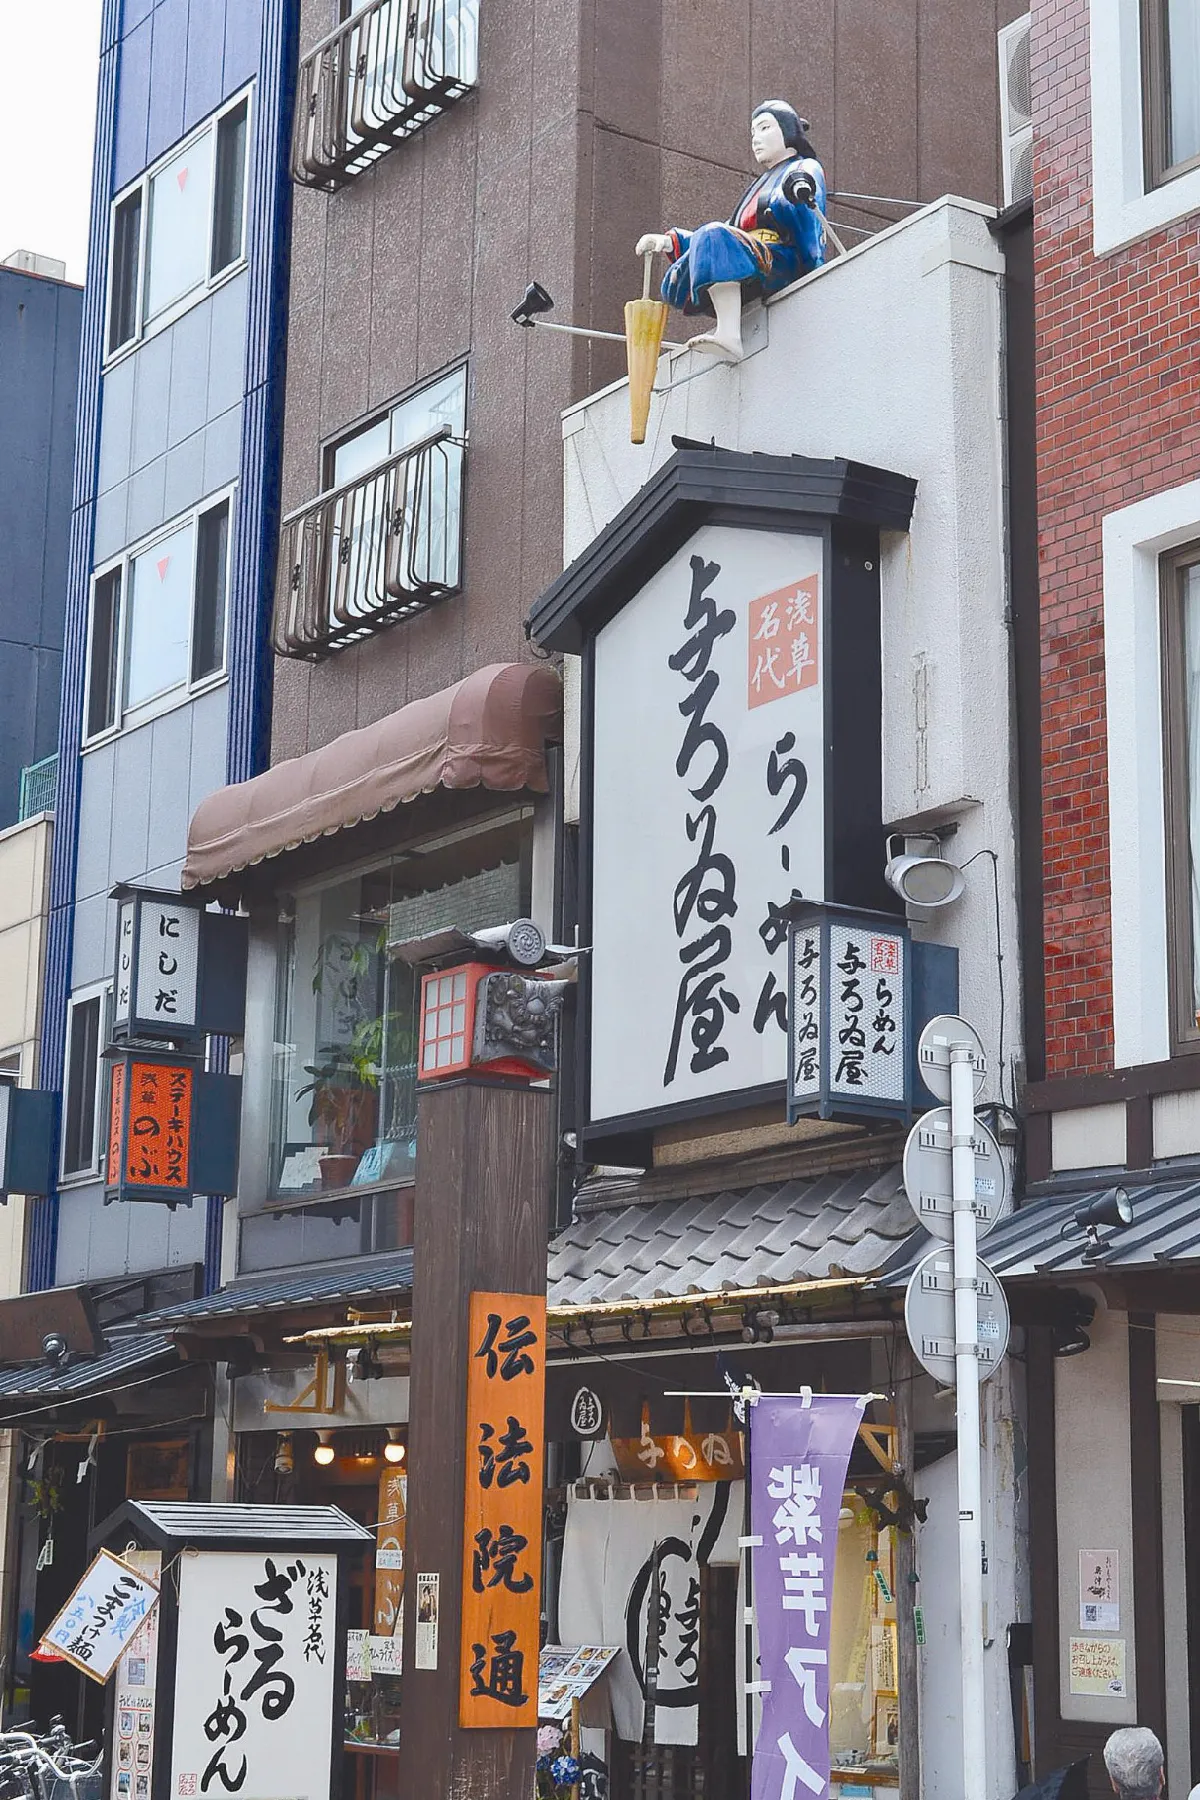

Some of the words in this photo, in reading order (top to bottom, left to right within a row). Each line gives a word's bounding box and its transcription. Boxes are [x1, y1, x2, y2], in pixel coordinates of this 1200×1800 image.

[751, 601, 787, 693] 名代
[785, 588, 816, 686] 浅草
[119, 919, 132, 1005] にしだ
[155, 914, 180, 1013] にしだ
[872, 977, 897, 1056] らめん
[129, 1115, 161, 1178] のぶ
[164, 1071, 187, 1182] ステーキハウス
[469, 1312, 538, 1707] 伝法院通
[67, 1576, 144, 1662] ごまつけ麺
[239, 1557, 306, 1721] ざる
[302, 1567, 330, 1665] 浅草名代
[200, 1607, 250, 1793] らーめん
